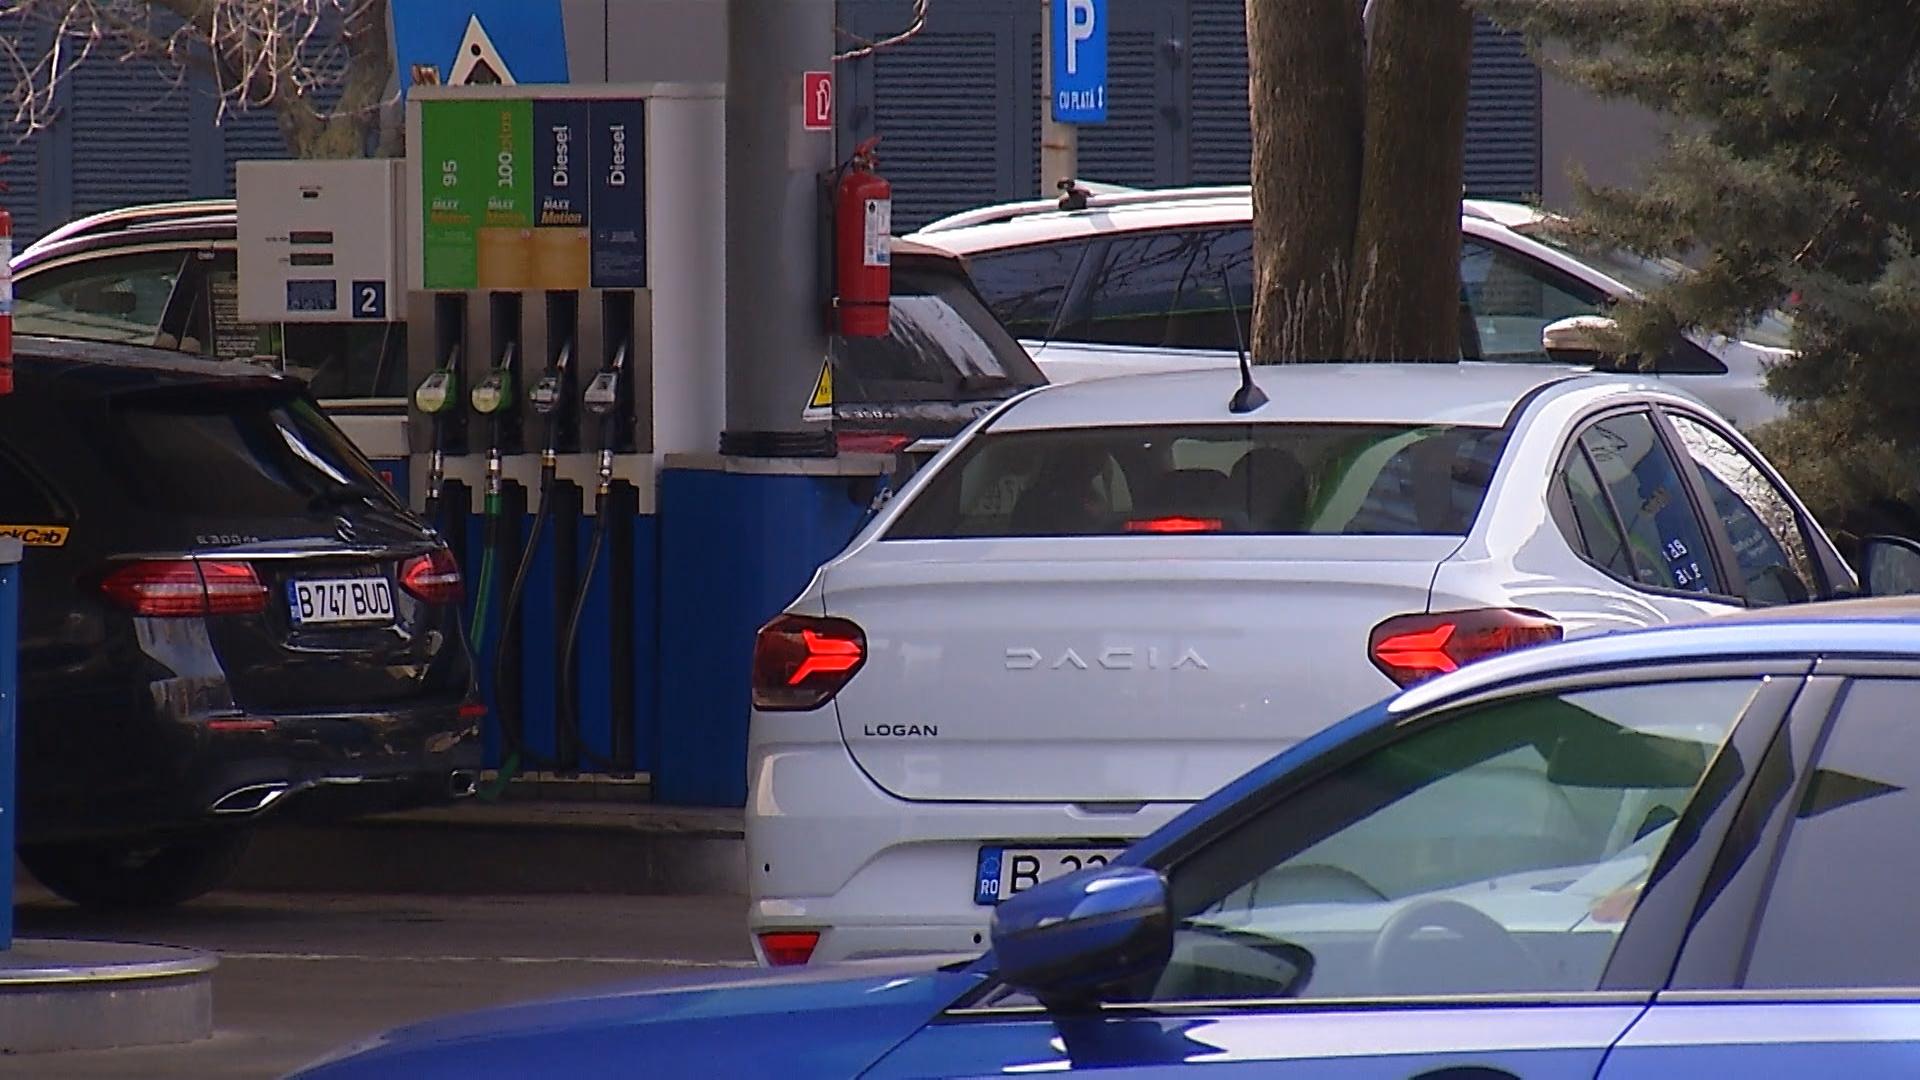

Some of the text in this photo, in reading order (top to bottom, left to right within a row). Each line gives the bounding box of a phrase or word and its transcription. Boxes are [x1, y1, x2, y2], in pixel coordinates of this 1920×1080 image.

[1067, 0, 1095, 74] P
[1059, 91, 1070, 109] CU
[552, 125, 568, 187] Diesel
[609, 125, 625, 187] Diesel
[442, 160, 457, 187] 95
[541, 211, 582, 224] Motion
[543, 200, 569, 210] MAXX
[361, 287, 377, 313] 2
[299, 586, 314, 618] B
[315, 584, 347, 617] 747
[351, 583, 391, 614] BUD
[1005, 648, 1209, 670] DACIA
[864, 724, 938, 736] LOGAN
[981, 879, 999, 895] RO
[1010, 855, 1041, 894] B
